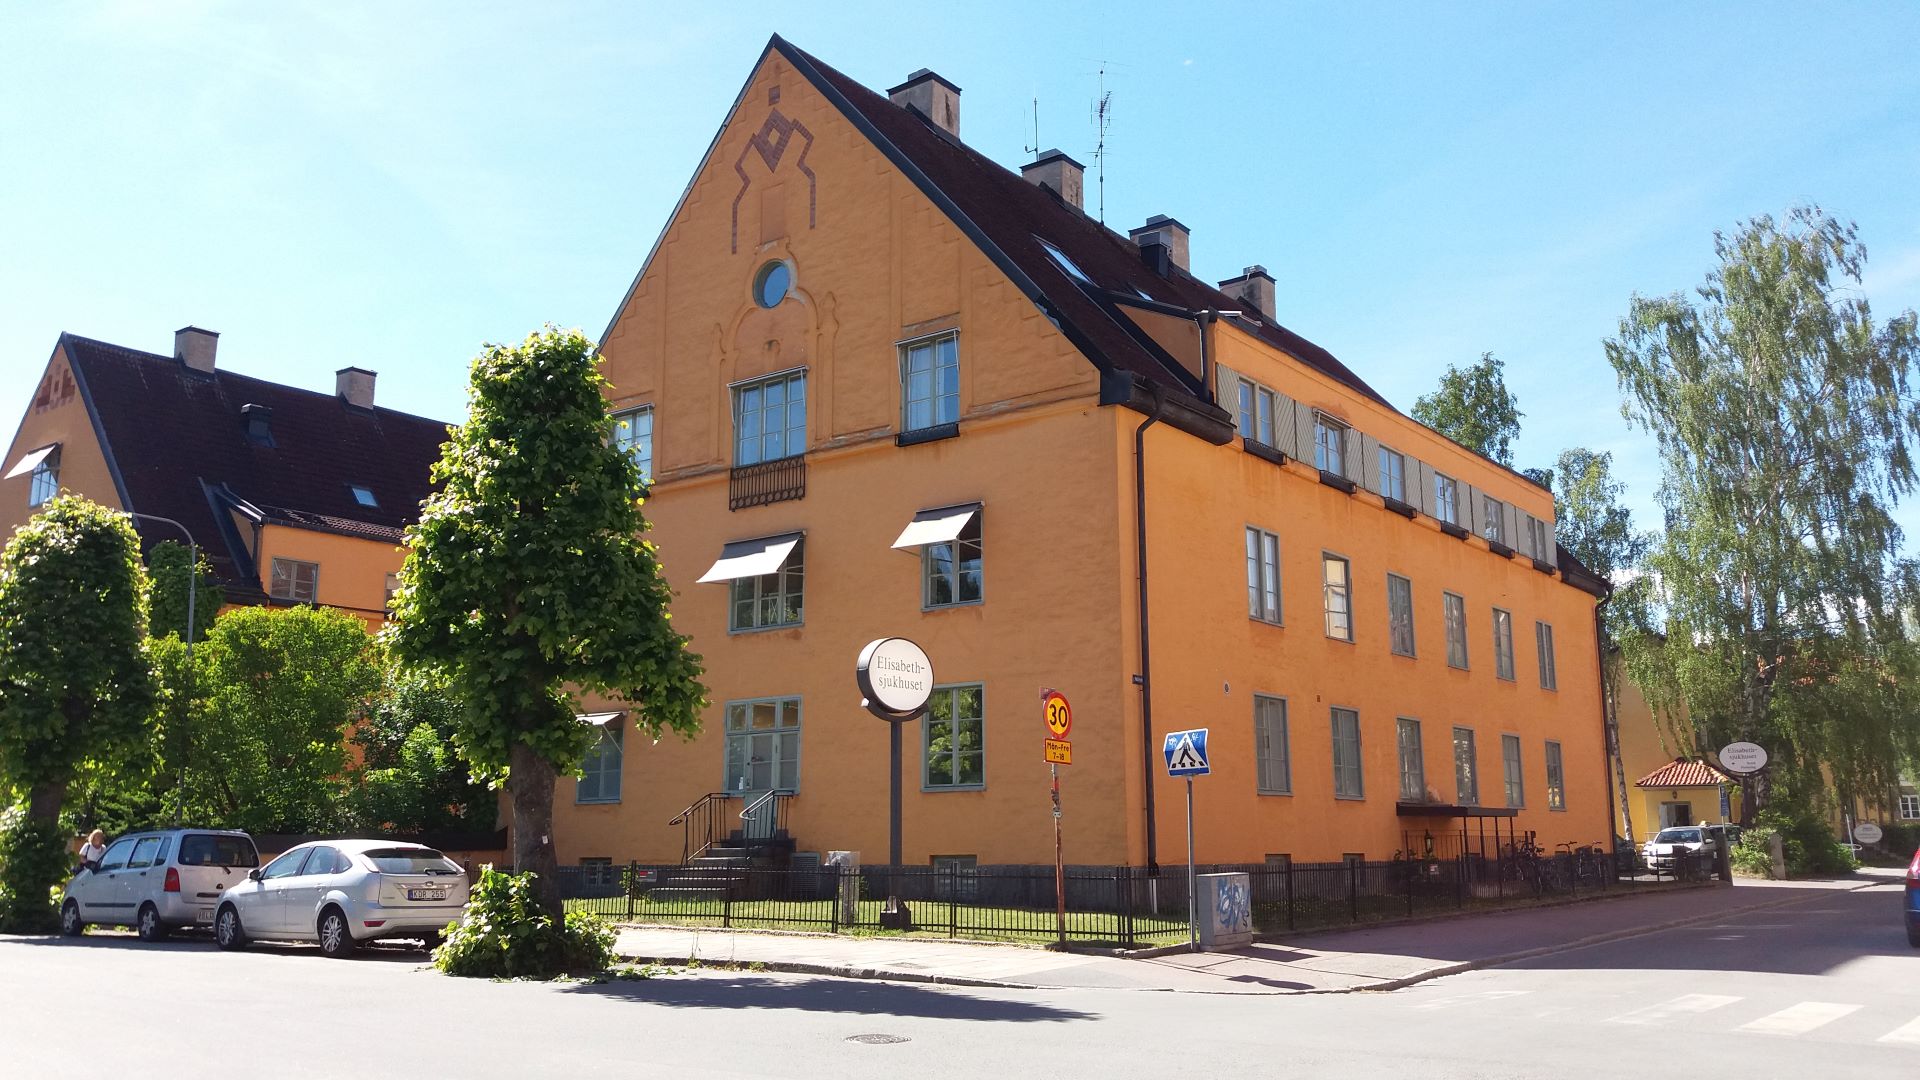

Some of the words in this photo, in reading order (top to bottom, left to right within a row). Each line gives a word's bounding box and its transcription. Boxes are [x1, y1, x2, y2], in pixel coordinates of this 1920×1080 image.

[877, 656, 925, 674] Elisabeth-
[879, 674, 923, 691] sjukhuset
[1049, 704, 1067, 728] 30
